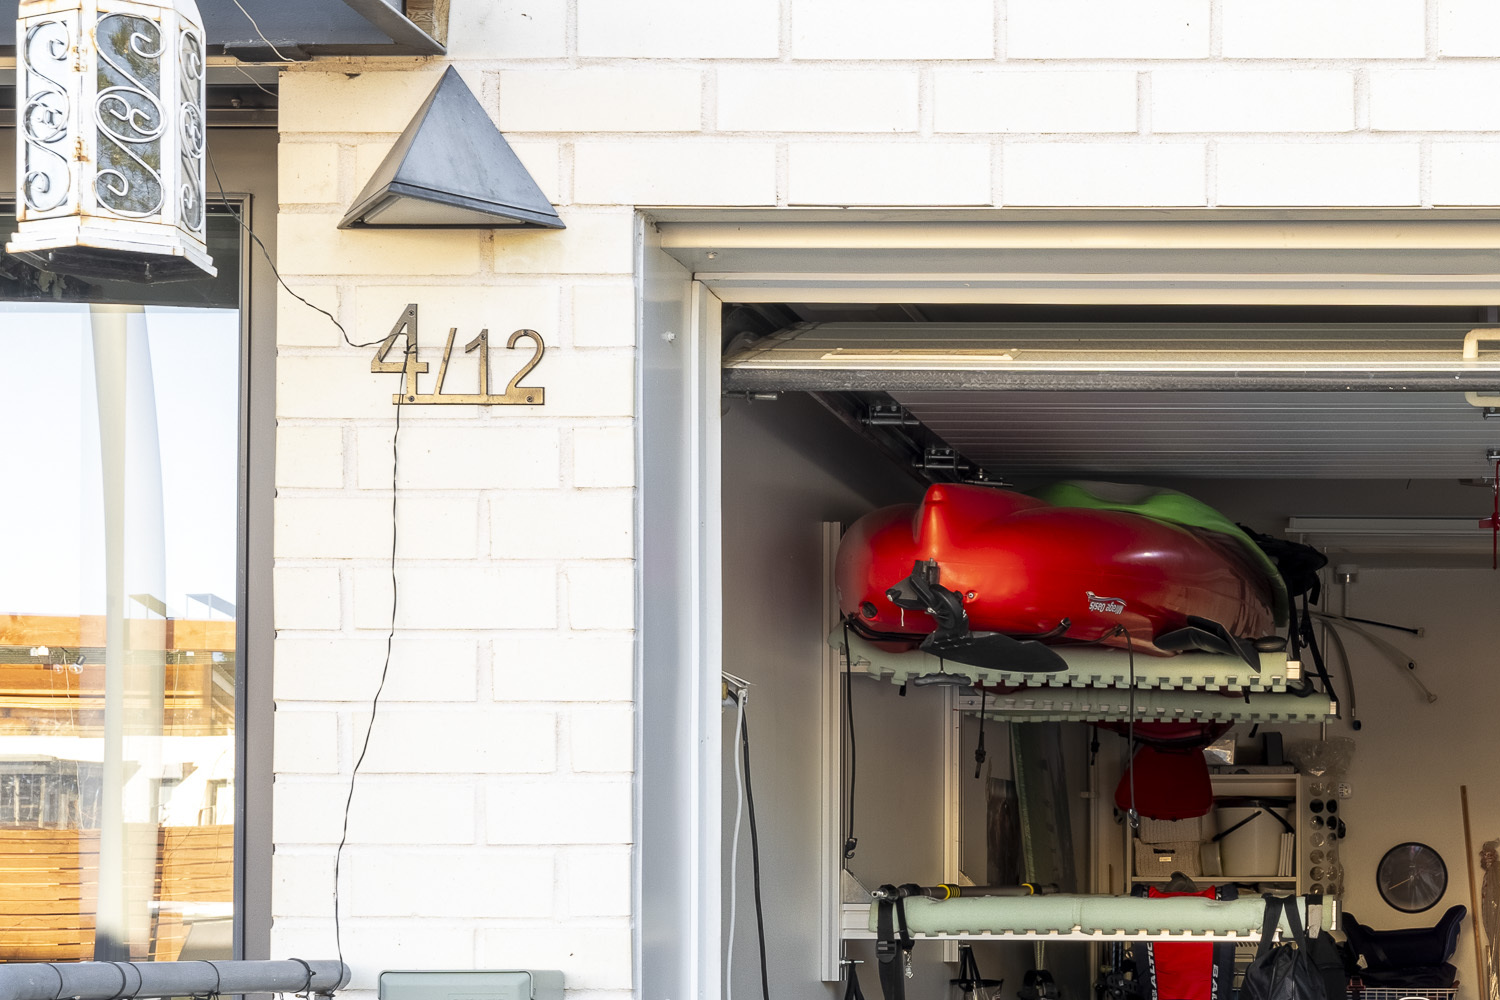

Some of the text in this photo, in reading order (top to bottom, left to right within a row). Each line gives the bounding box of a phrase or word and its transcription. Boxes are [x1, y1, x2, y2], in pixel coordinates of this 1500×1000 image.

[371, 303, 545, 405] 4/12
[1089, 601, 1124, 615] Mirage Oasis
